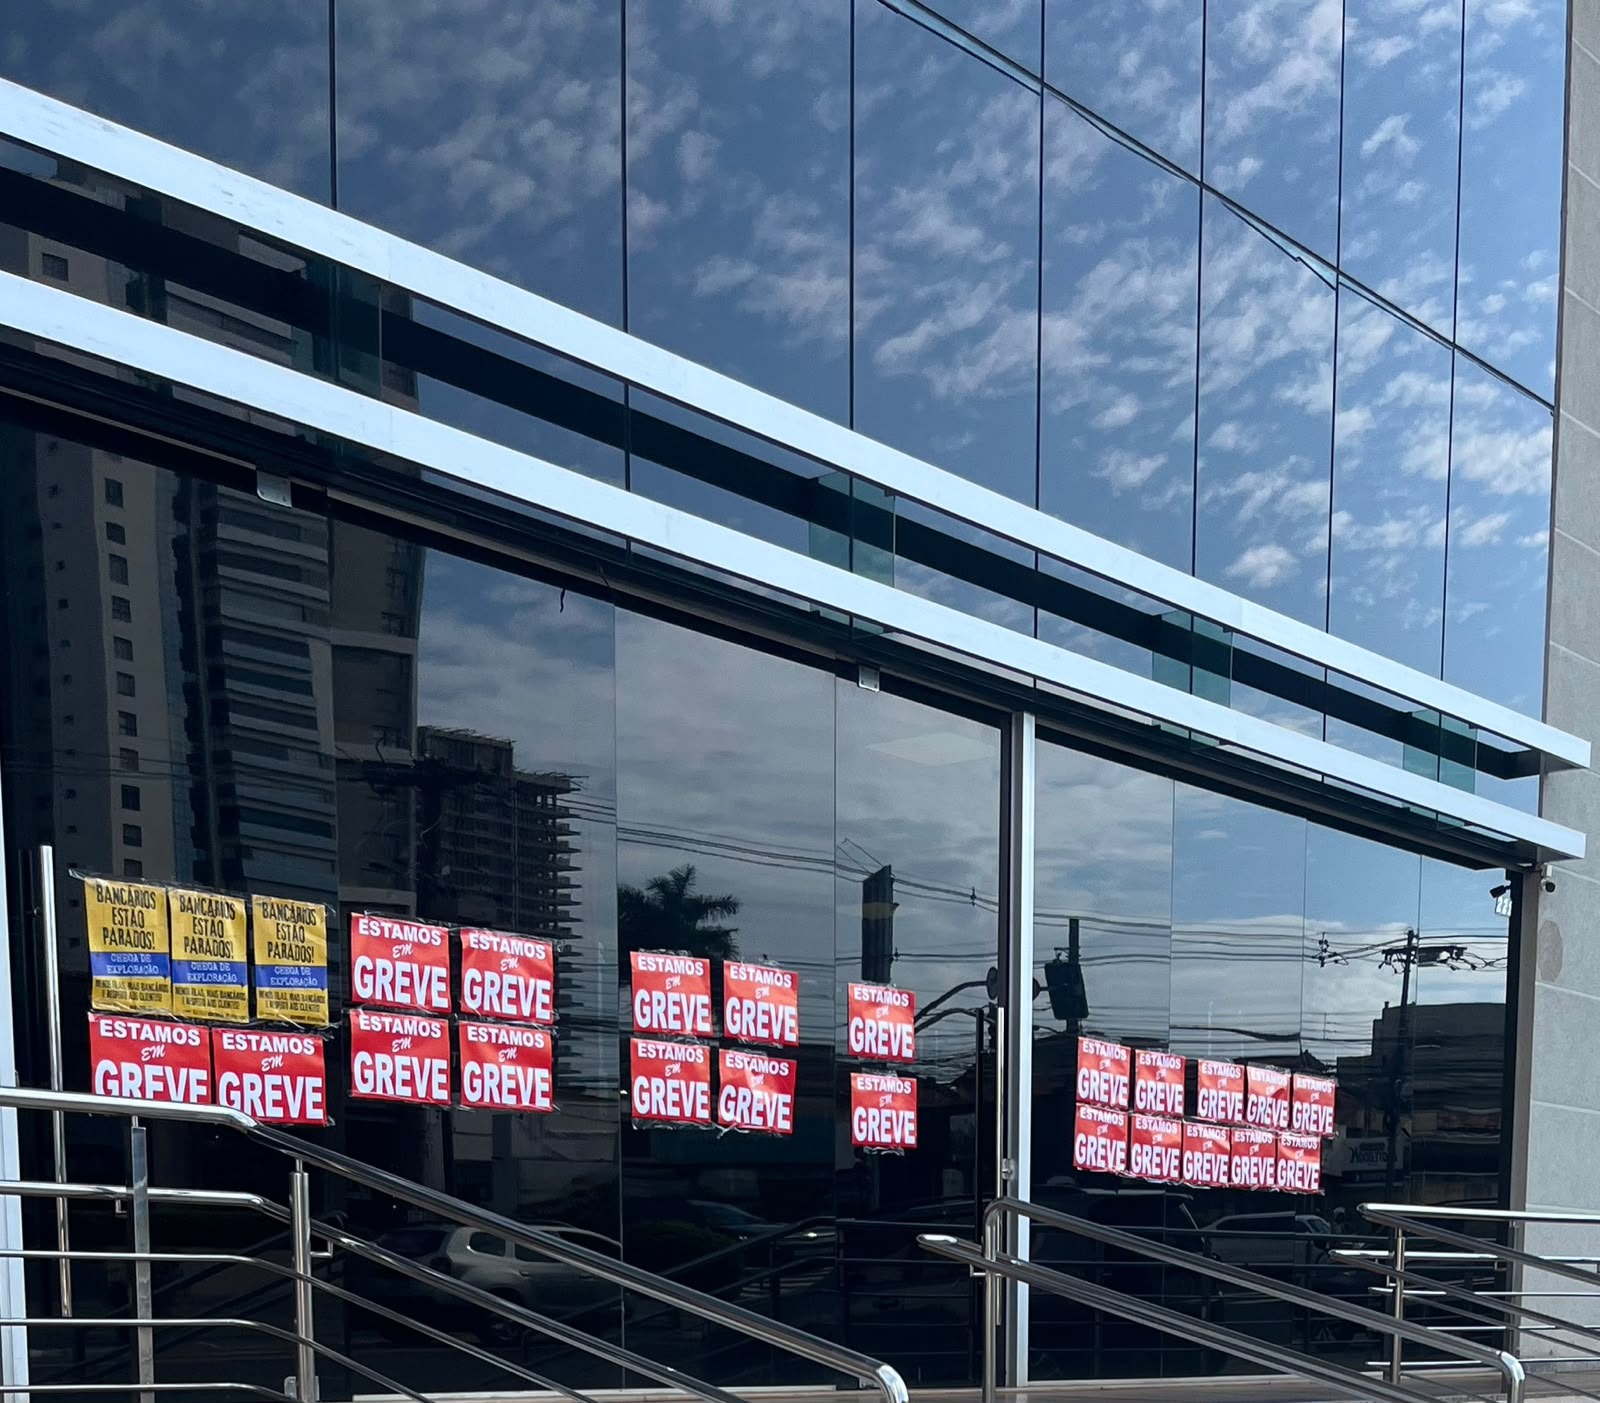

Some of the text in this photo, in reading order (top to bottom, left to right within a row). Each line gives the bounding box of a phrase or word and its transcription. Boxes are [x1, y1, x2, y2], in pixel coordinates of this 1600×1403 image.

[102, 927, 155, 950] PARADOS!
[358, 918, 442, 946] ESTAMOS
[184, 936, 234, 960] PARADOS!
[267, 941, 315, 963] PARADOS!
[392, 943, 413, 959] EM
[469, 932, 546, 960] ESTAMOS
[141, 954, 152, 963] DE
[219, 962, 231, 972] DE
[500, 957, 519, 971] EM
[637, 955, 704, 977] ESTAMOS
[300, 967, 312, 975] DE
[354, 955, 449, 1009] GREVE
[665, 975, 681, 990] EM
[729, 965, 792, 988] ESTAMOS
[464, 968, 551, 1020] GREVE
[754, 986, 770, 999] EM
[853, 986, 909, 1007] ESTAMOS
[634, 988, 711, 1032] GREVE
[725, 997, 797, 1043] GREVE
[100, 1019, 200, 1046] ESTAMOS
[358, 1014, 442, 1039] ESTAMOS
[467, 1025, 545, 1049] ESTAMOS
[850, 1016, 914, 1058] GREVE
[141, 1044, 165, 1062] EM
[222, 1033, 315, 1055] ESTAMOS
[391, 1037, 412, 1053] EM
[498, 1047, 518, 1062] EM
[637, 1043, 704, 1064] ESTAMOS
[1082, 1040, 1127, 1061] ESTAMOS
[261, 1054, 283, 1072] EM
[664, 1062, 681, 1077] EM
[725, 1053, 789, 1076] ESTAMOS
[1140, 1053, 1181, 1070] ESTAMOS
[1202, 1062, 1241, 1079] ESTAMOS
[94, 1059, 208, 1104] GREVE
[353, 1051, 448, 1100] GREVE
[463, 1061, 551, 1108] GREVE
[856, 1076, 912, 1095] ESTAMOS
[1077, 1067, 1128, 1107] GREVE
[1251, 1070, 1288, 1087] ESTAMOS
[1296, 1077, 1333, 1093] ESTAMOS
[218, 1071, 324, 1120] GREVE
[633, 1075, 710, 1120] GREVE
[719, 1084, 792, 1130] GREVE
[878, 1093, 893, 1108] EM
[1135, 1079, 1184, 1115] GREVE
[1199, 1087, 1244, 1121] GREVE
[1080, 1106, 1124, 1126] ESTAMOS
[1246, 1093, 1289, 1128] GREVE
[1292, 1101, 1334, 1134] GREVE
[853, 1106, 916, 1145] GREVE
[1135, 1118, 1178, 1134] ESTAMOS
[1187, 1126, 1227, 1141] ESTAMOS
[1234, 1130, 1273, 1144] ESTAMOS
[1075, 1133, 1127, 1171] GREVE
[1281, 1135, 1318, 1150] ESTAMOS
[1131, 1143, 1180, 1178] GREVE
[1183, 1150, 1229, 1184] GREVE
[1231, 1155, 1276, 1185] GREVE
[1277, 1158, 1320, 1190] GREVE
